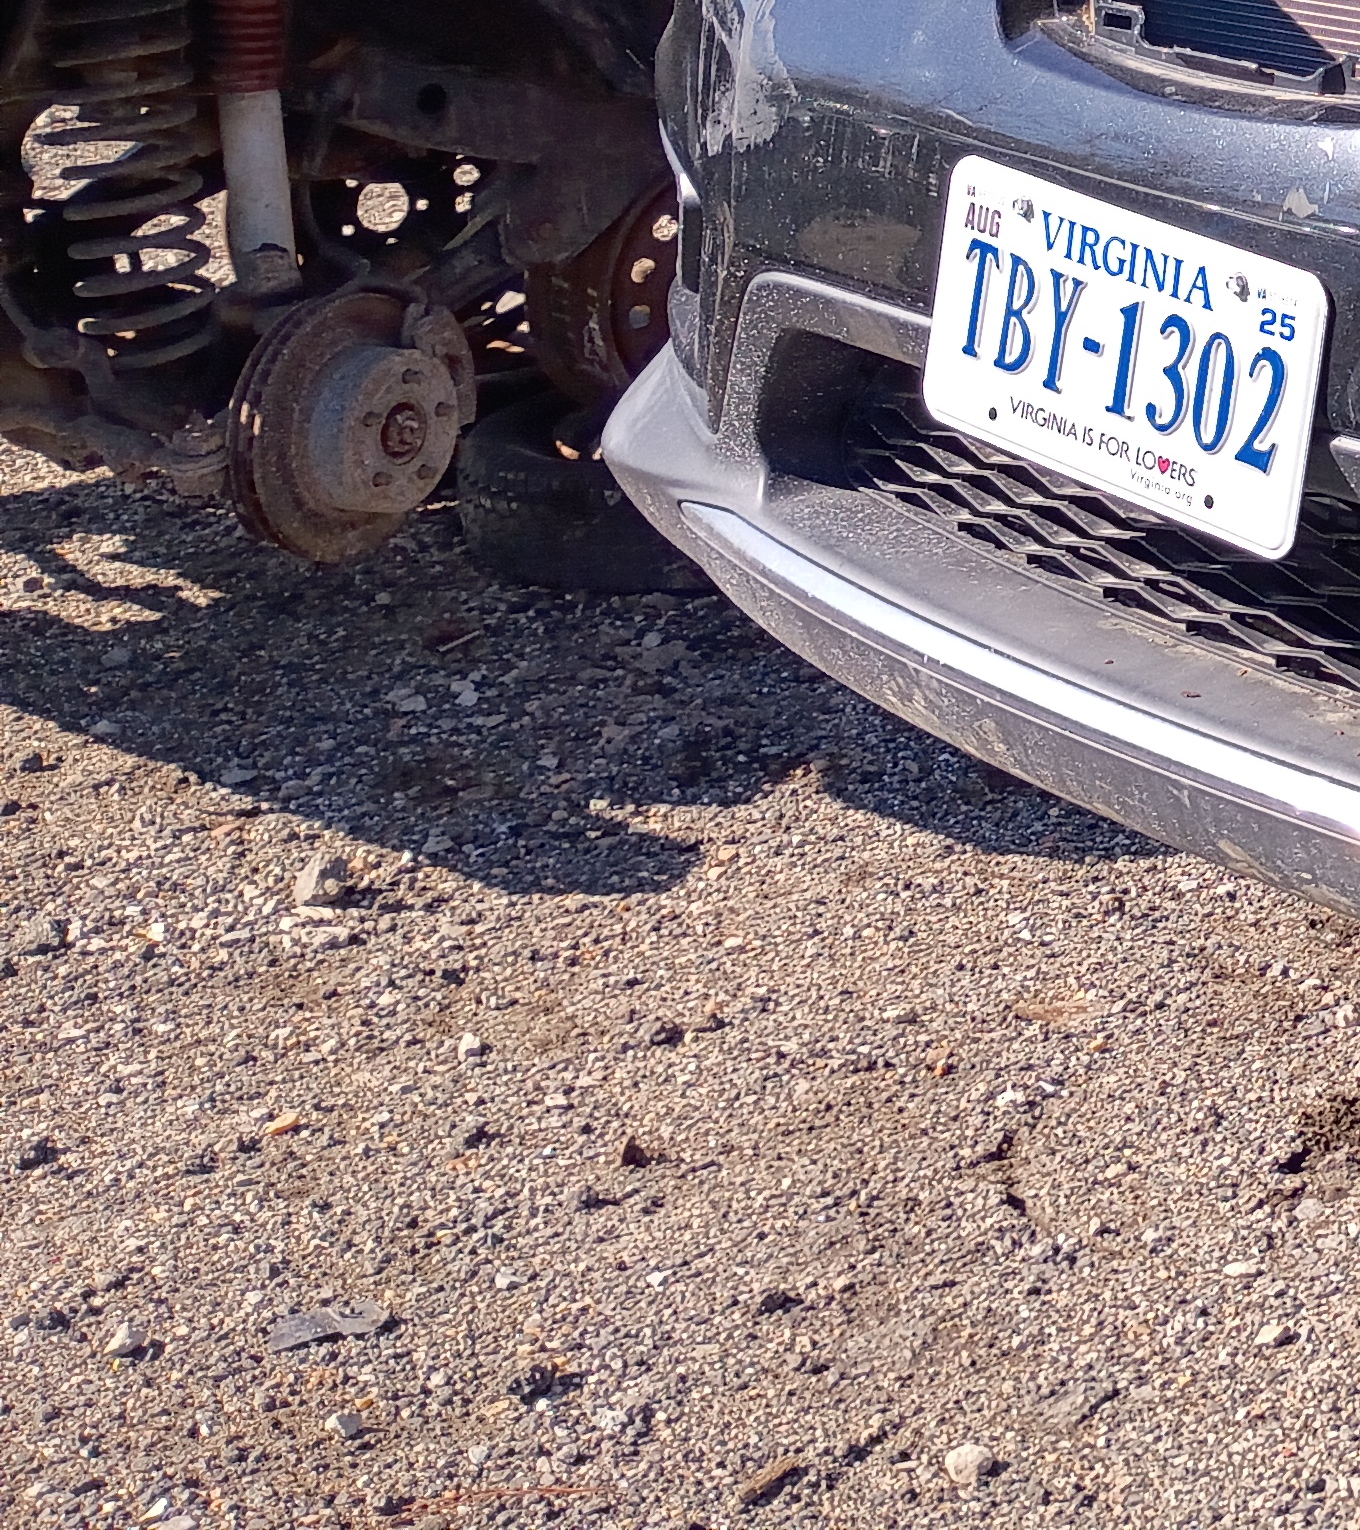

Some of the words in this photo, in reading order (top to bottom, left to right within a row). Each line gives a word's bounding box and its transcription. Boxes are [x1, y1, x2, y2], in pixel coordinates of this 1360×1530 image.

[964, 202, 1002, 238] AUG
[1041, 209, 1214, 312] VIRGINIA
[1259, 307, 1296, 342] 25
[961, 237, 1288, 475] TBY-1302
[1009, 395, 1078, 441] VIRGINIA
[1082, 425, 1095, 447] IS
[1098, 432, 1131, 462] FOR
[1130, 468, 1193, 507] Virginiaorg
